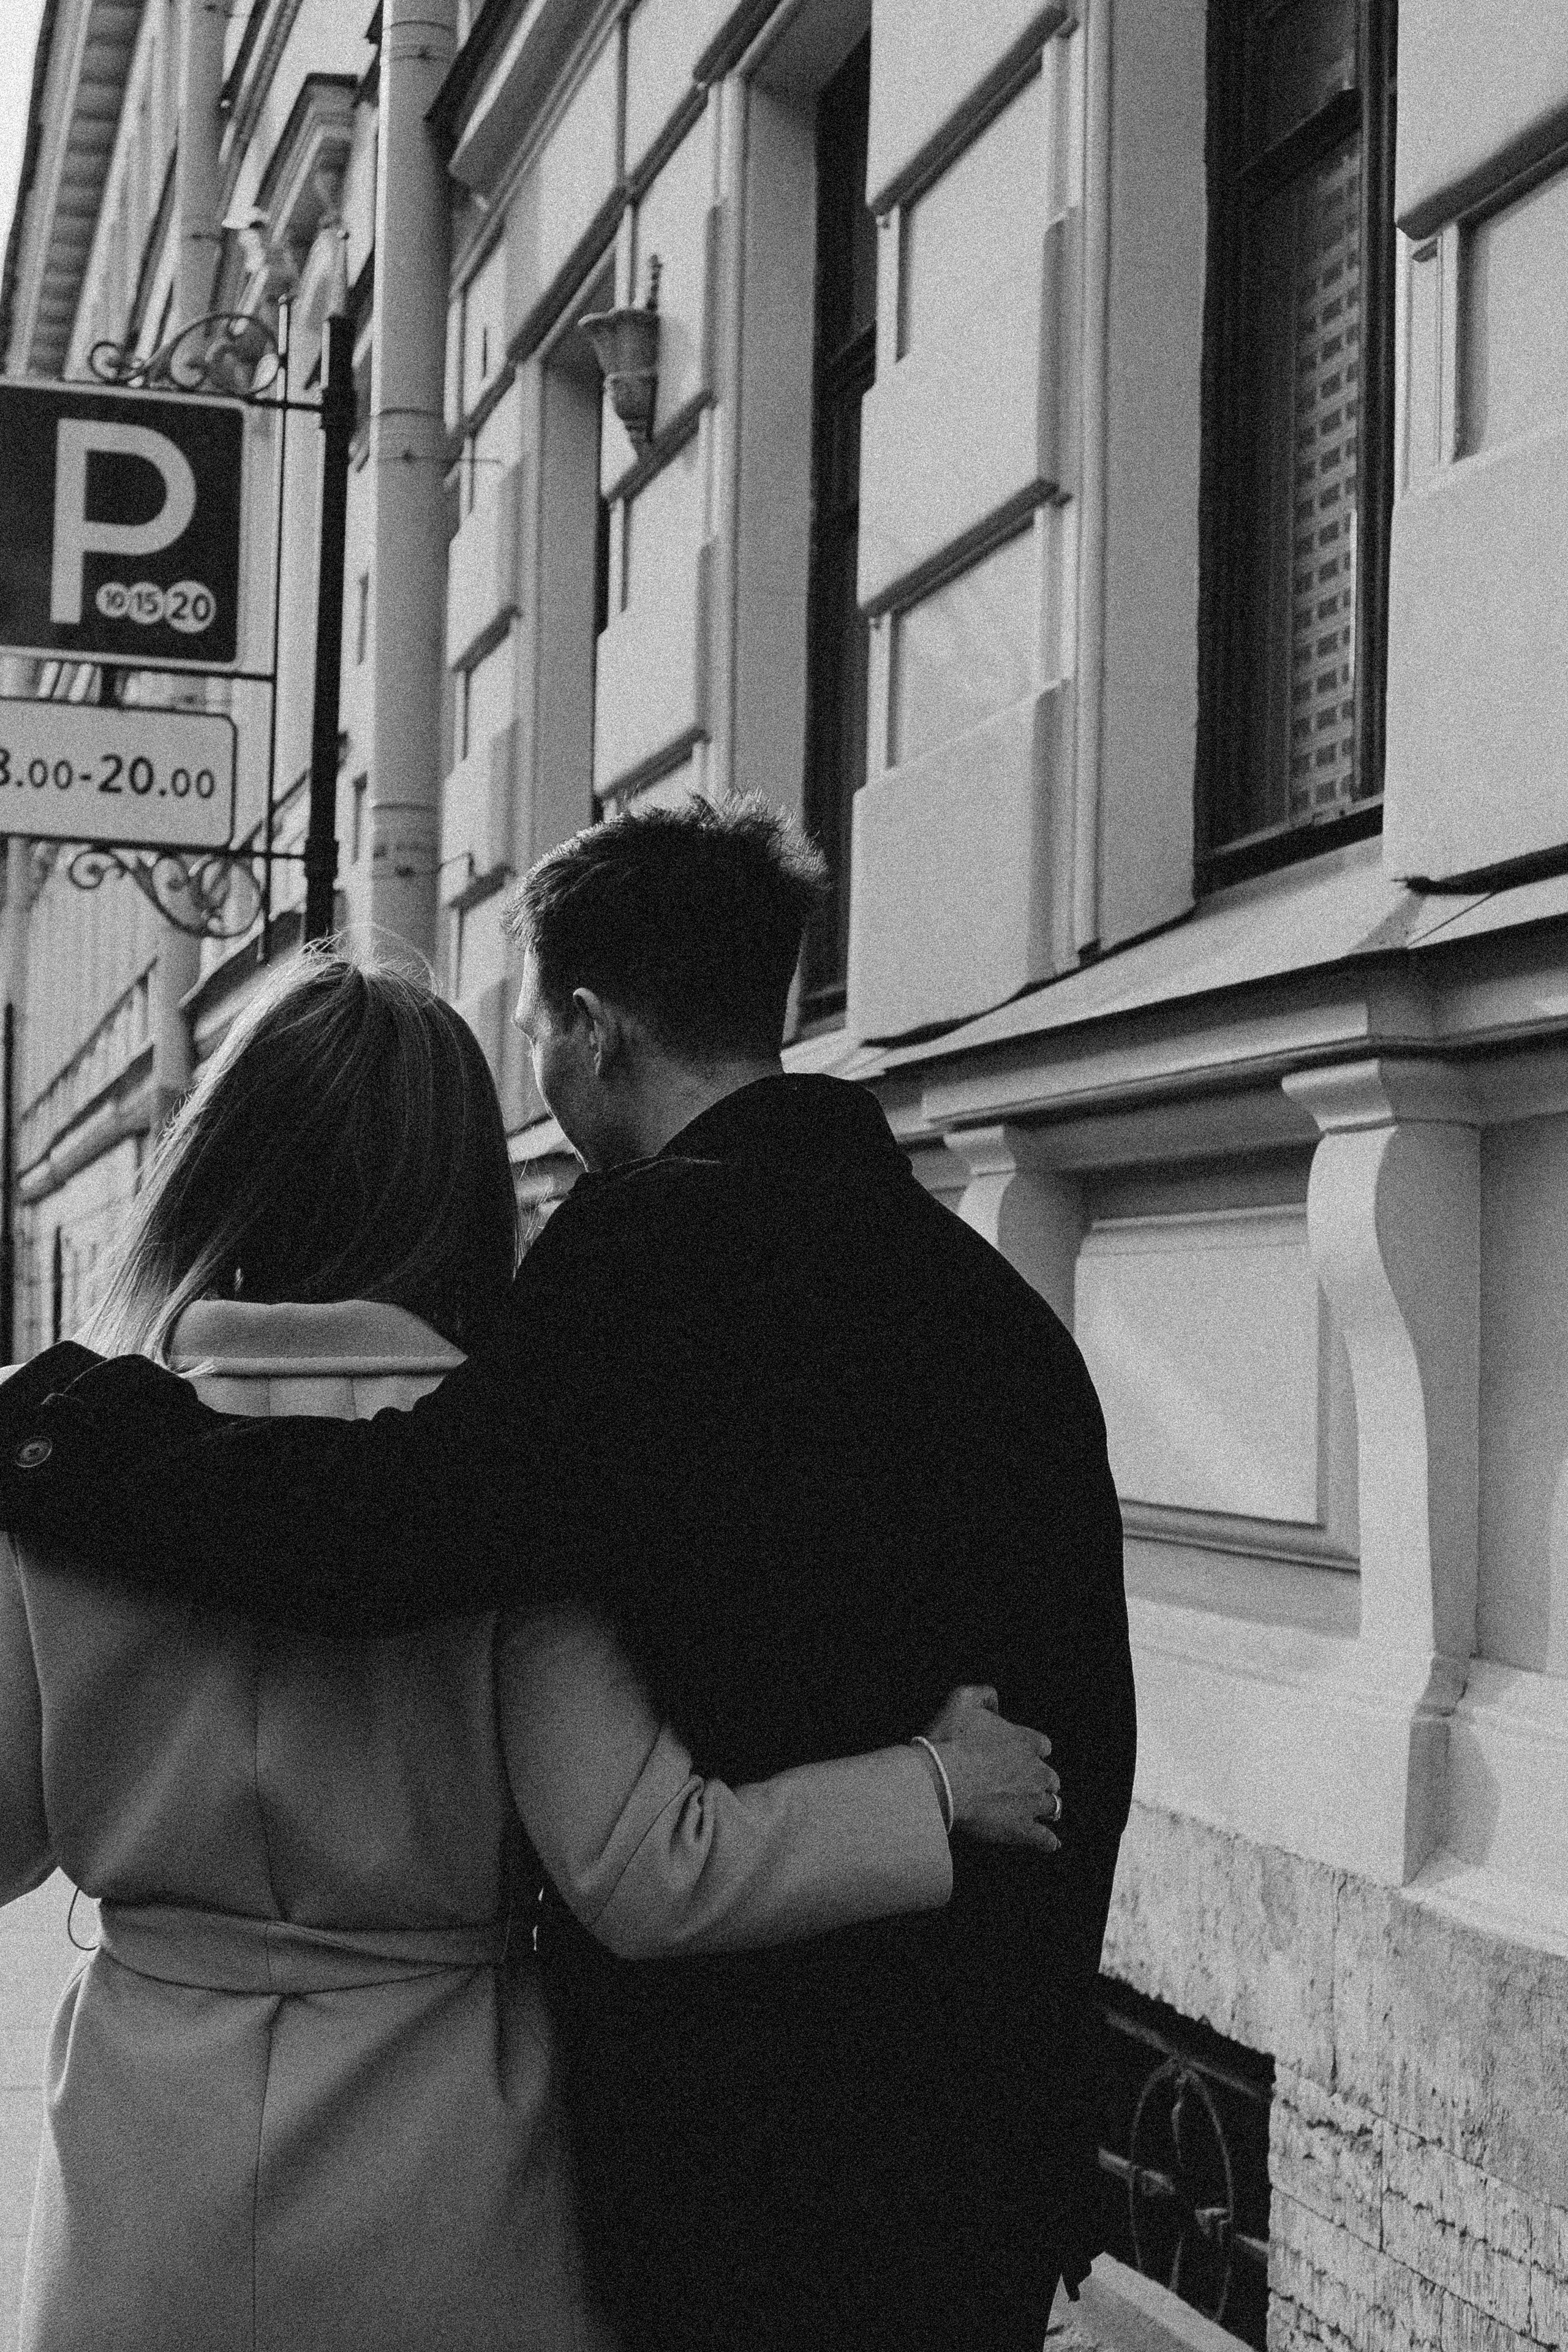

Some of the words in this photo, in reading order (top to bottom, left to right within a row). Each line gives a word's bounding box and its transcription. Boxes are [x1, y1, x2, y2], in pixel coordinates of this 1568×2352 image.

[50, 418, 197, 624] P
[105, 591, 124, 609] 10
[136, 592, 159, 615] 15
[171, 591, 211, 622] 20
